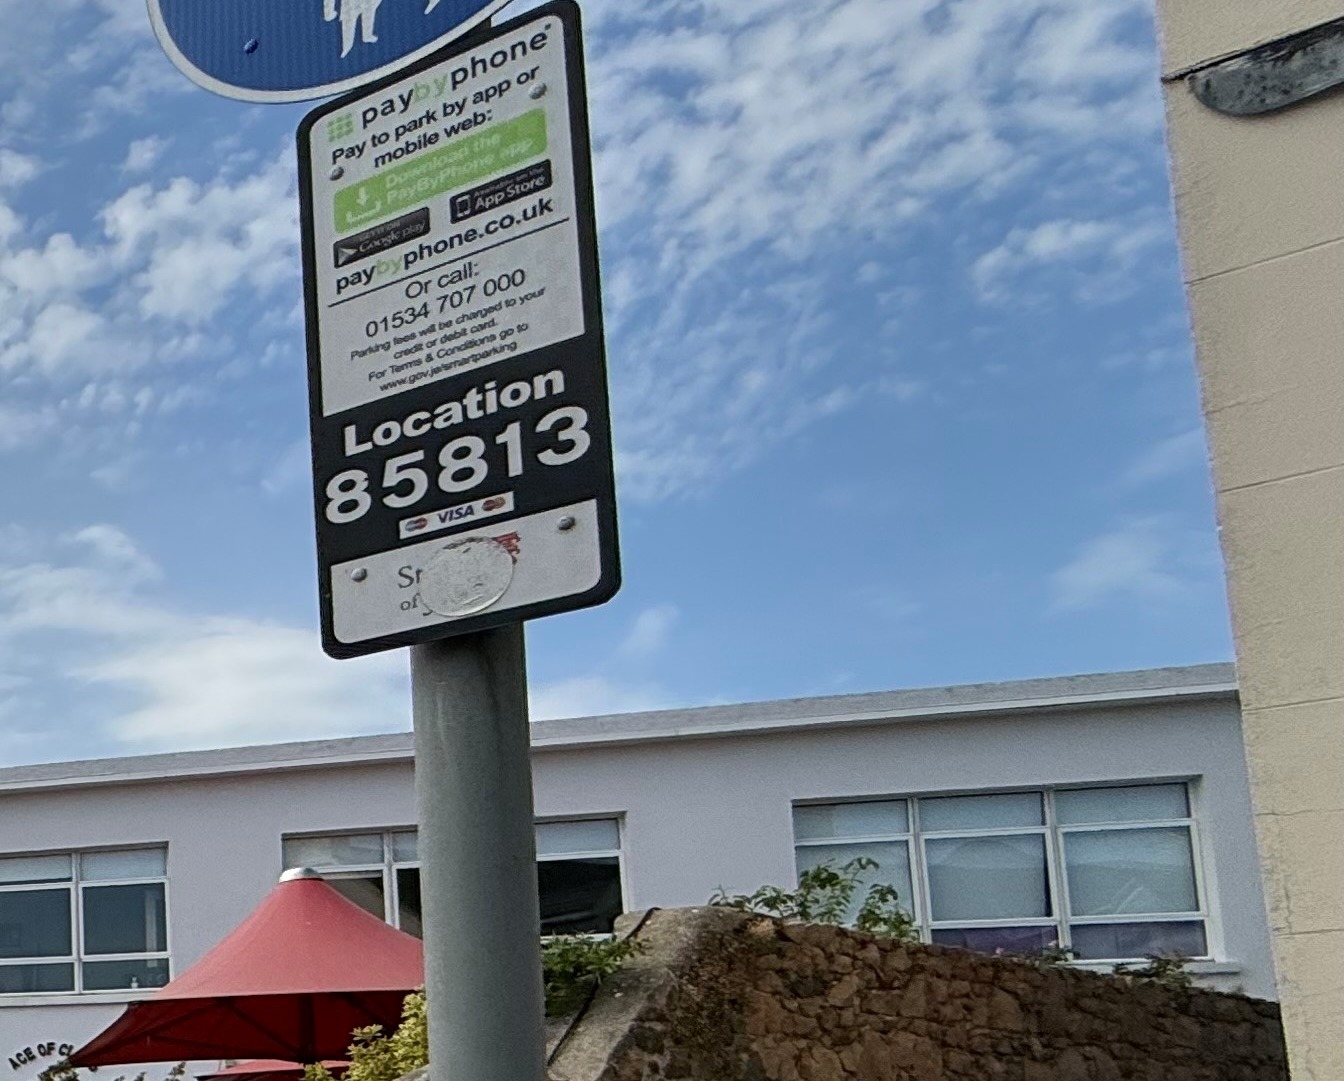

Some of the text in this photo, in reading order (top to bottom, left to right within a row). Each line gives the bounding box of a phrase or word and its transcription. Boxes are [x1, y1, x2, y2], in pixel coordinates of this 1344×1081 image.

[331, 65, 540, 165] Pay to park by app or
[374, 109, 493, 168] mobile web:
[506, 175, 546, 203] Store
[336, 197, 554, 295] paybyphone.co.uk
[365, 268, 526, 338] 01534 707 000
[405, 261, 480, 298] Or call:
[350, 340, 391, 360] Parking
[393, 332, 417, 345] fees
[438, 318, 453, 330] be
[455, 300, 503, 326] charged
[504, 297, 517, 308] to
[368, 323, 529, 382] For Terms & Conditions go to
[393, 317, 499, 360] credit or debit card.
[344, 369, 565, 457] Location
[324, 405, 592, 524] 85813
[438, 505, 475, 523] VISA
[8, 1047, 36, 1071] ACE
[37, 1042, 56, 1056] OF
